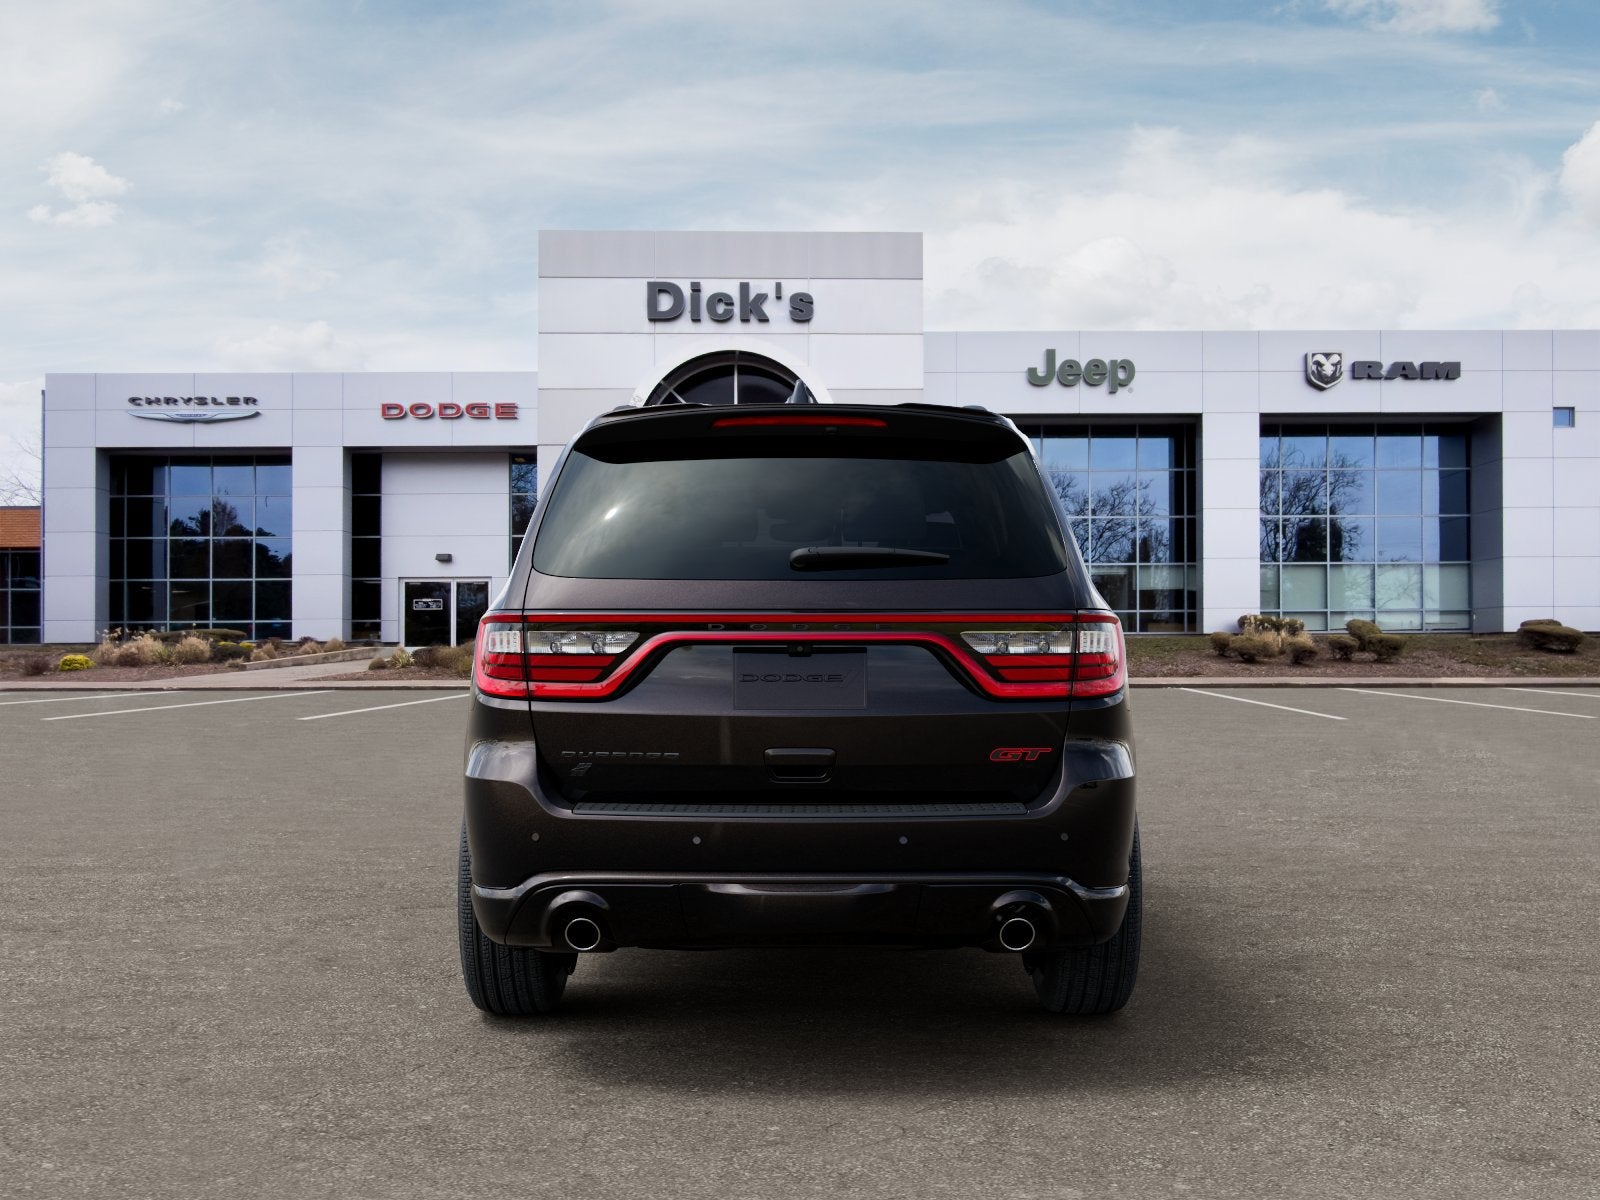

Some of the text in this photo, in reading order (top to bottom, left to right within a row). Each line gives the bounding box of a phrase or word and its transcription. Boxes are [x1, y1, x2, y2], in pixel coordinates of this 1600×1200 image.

[647, 281, 814, 322] Dick's
[1027, 348, 1136, 394] Jeep
[1352, 360, 1461, 380] RAM
[127, 396, 259, 407] CHRYSLER
[381, 402, 519, 420] DODGE
[739, 673, 845, 683] DODGE
[989, 747, 1053, 762] GT
